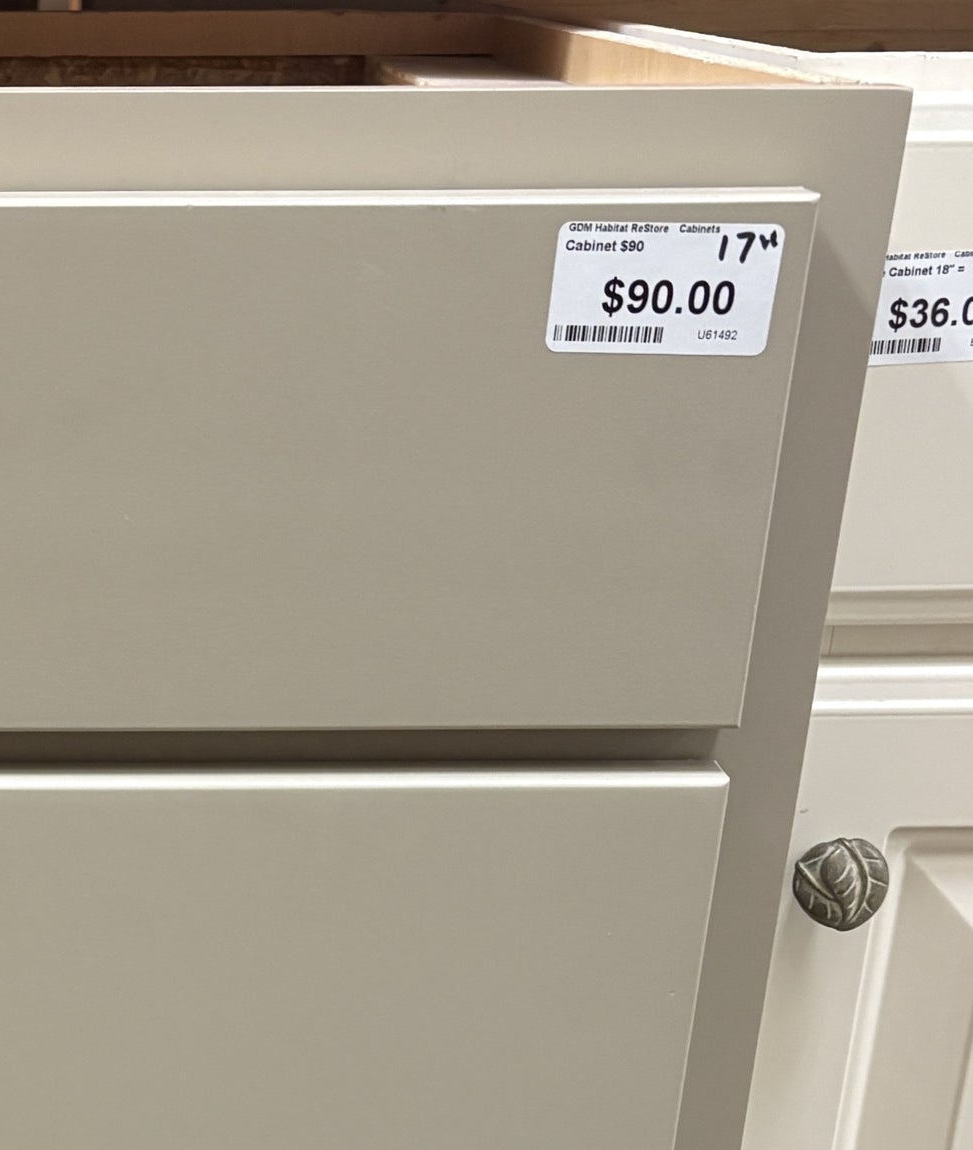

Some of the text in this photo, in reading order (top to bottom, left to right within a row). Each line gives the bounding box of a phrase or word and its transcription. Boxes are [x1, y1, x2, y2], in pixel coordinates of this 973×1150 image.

[569, 223, 721, 234] GDM Habitat ReStore Cabinets
[566, 240, 644, 252] Cabinet $90
[889, 266, 933, 277] Cabinet
[936, 264, 955, 275] 18"
[601, 276, 735, 317] $90.00
[697, 329, 738, 341] U61492
